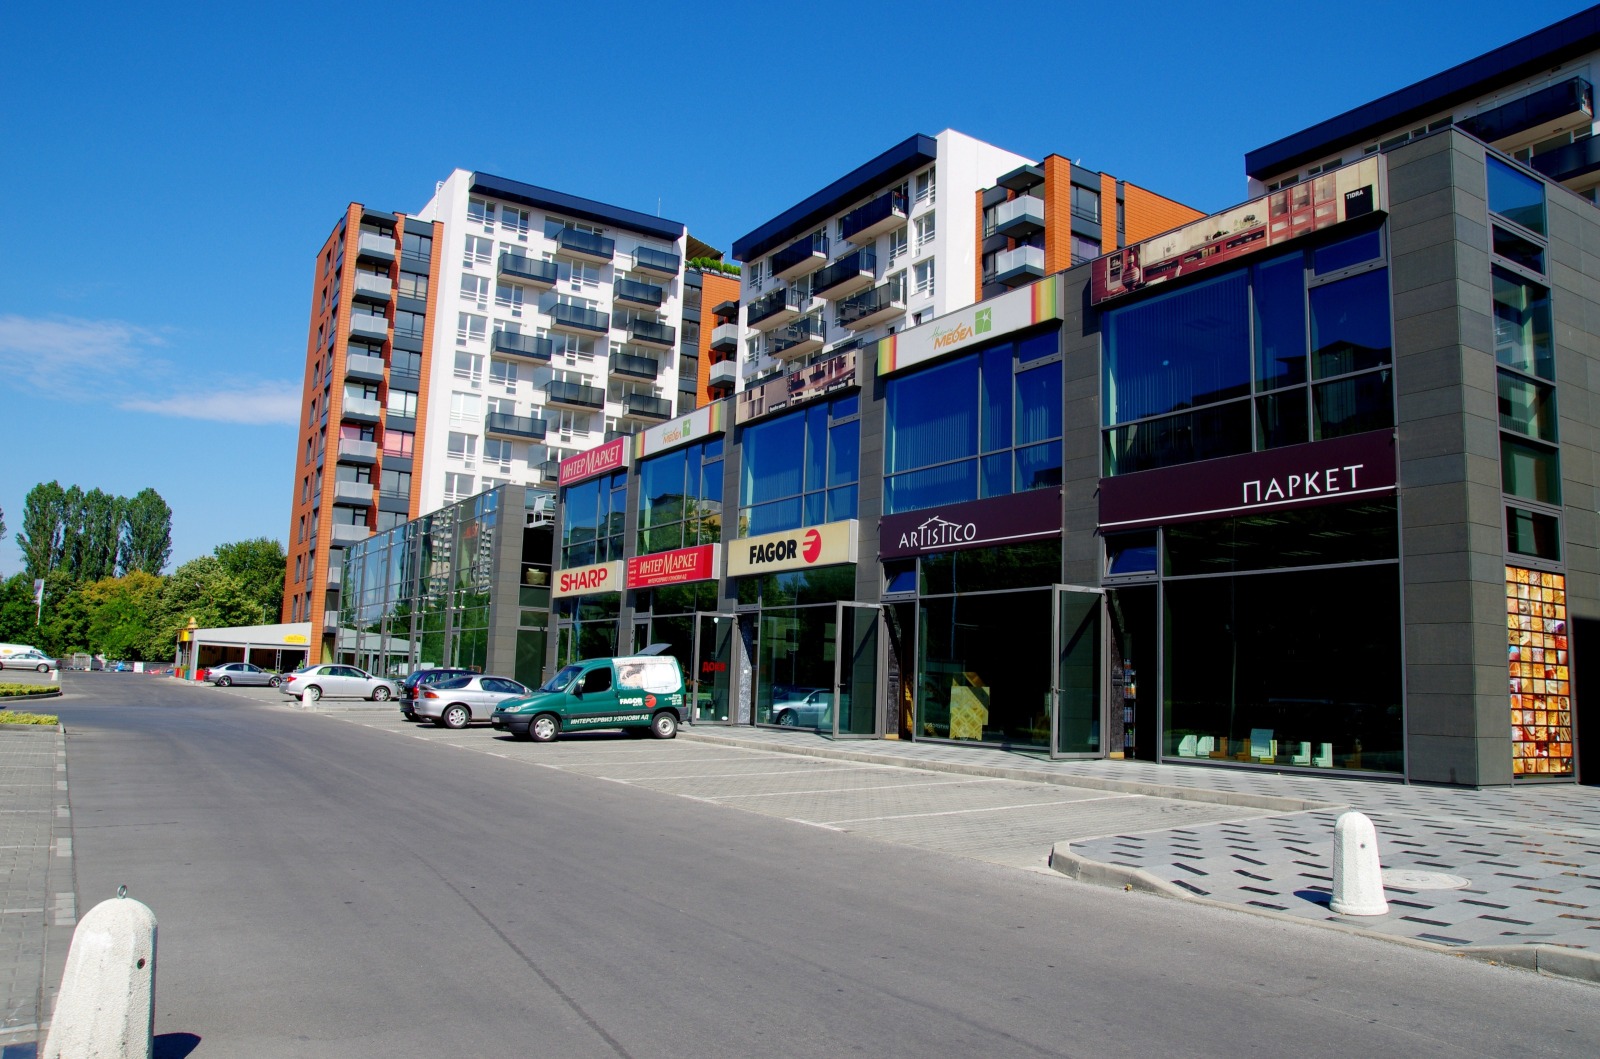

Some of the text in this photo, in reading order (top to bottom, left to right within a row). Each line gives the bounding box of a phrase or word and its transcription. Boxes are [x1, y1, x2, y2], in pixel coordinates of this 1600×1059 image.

[1243, 464, 1364, 503] ПАРКЕТ
[749, 539, 797, 564] FAGOR
[560, 568, 608, 592] SHARP
